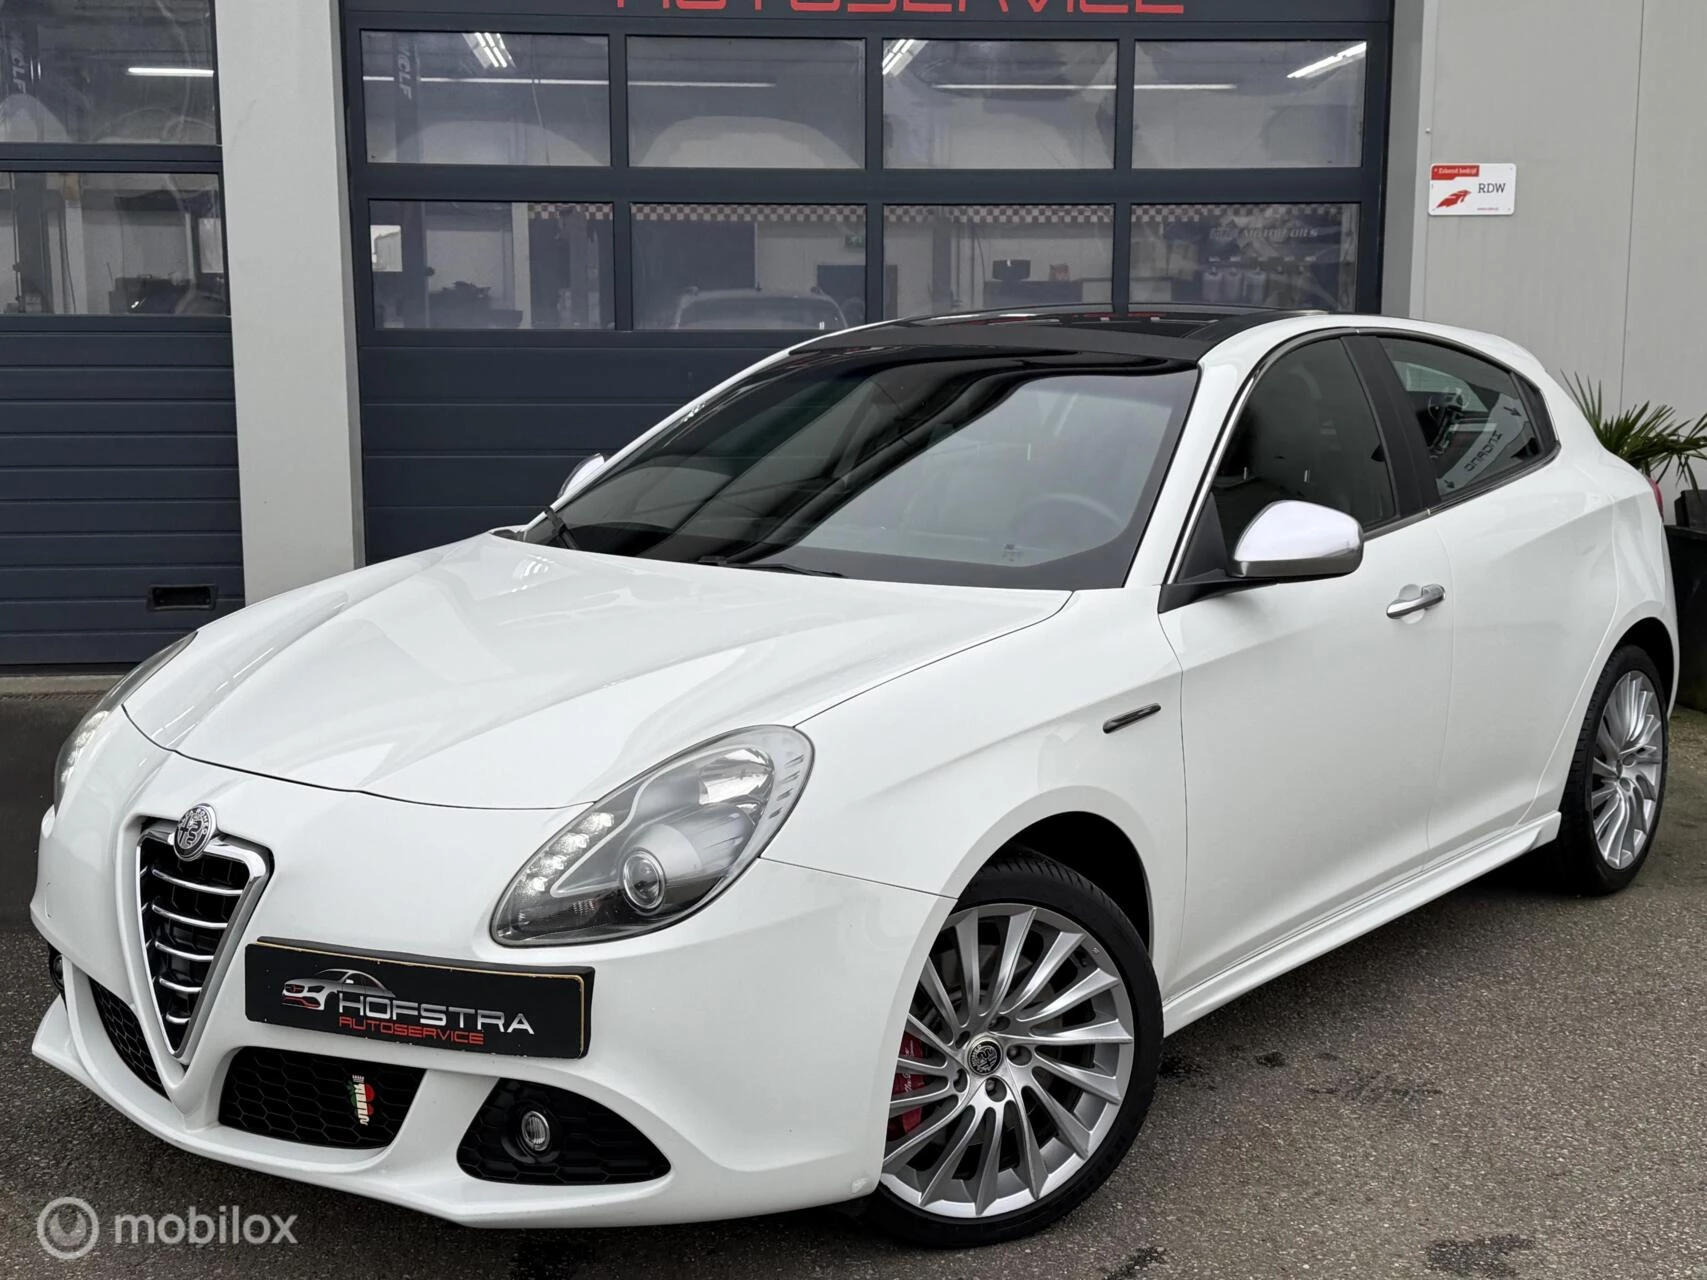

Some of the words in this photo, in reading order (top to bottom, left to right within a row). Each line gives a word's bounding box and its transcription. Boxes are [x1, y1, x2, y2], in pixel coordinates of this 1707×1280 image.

[1478, 182, 1506, 194] RDW
[338, 993, 535, 1035] HOFSTRA
[338, 1016, 485, 1046] AUTOSERVICE
